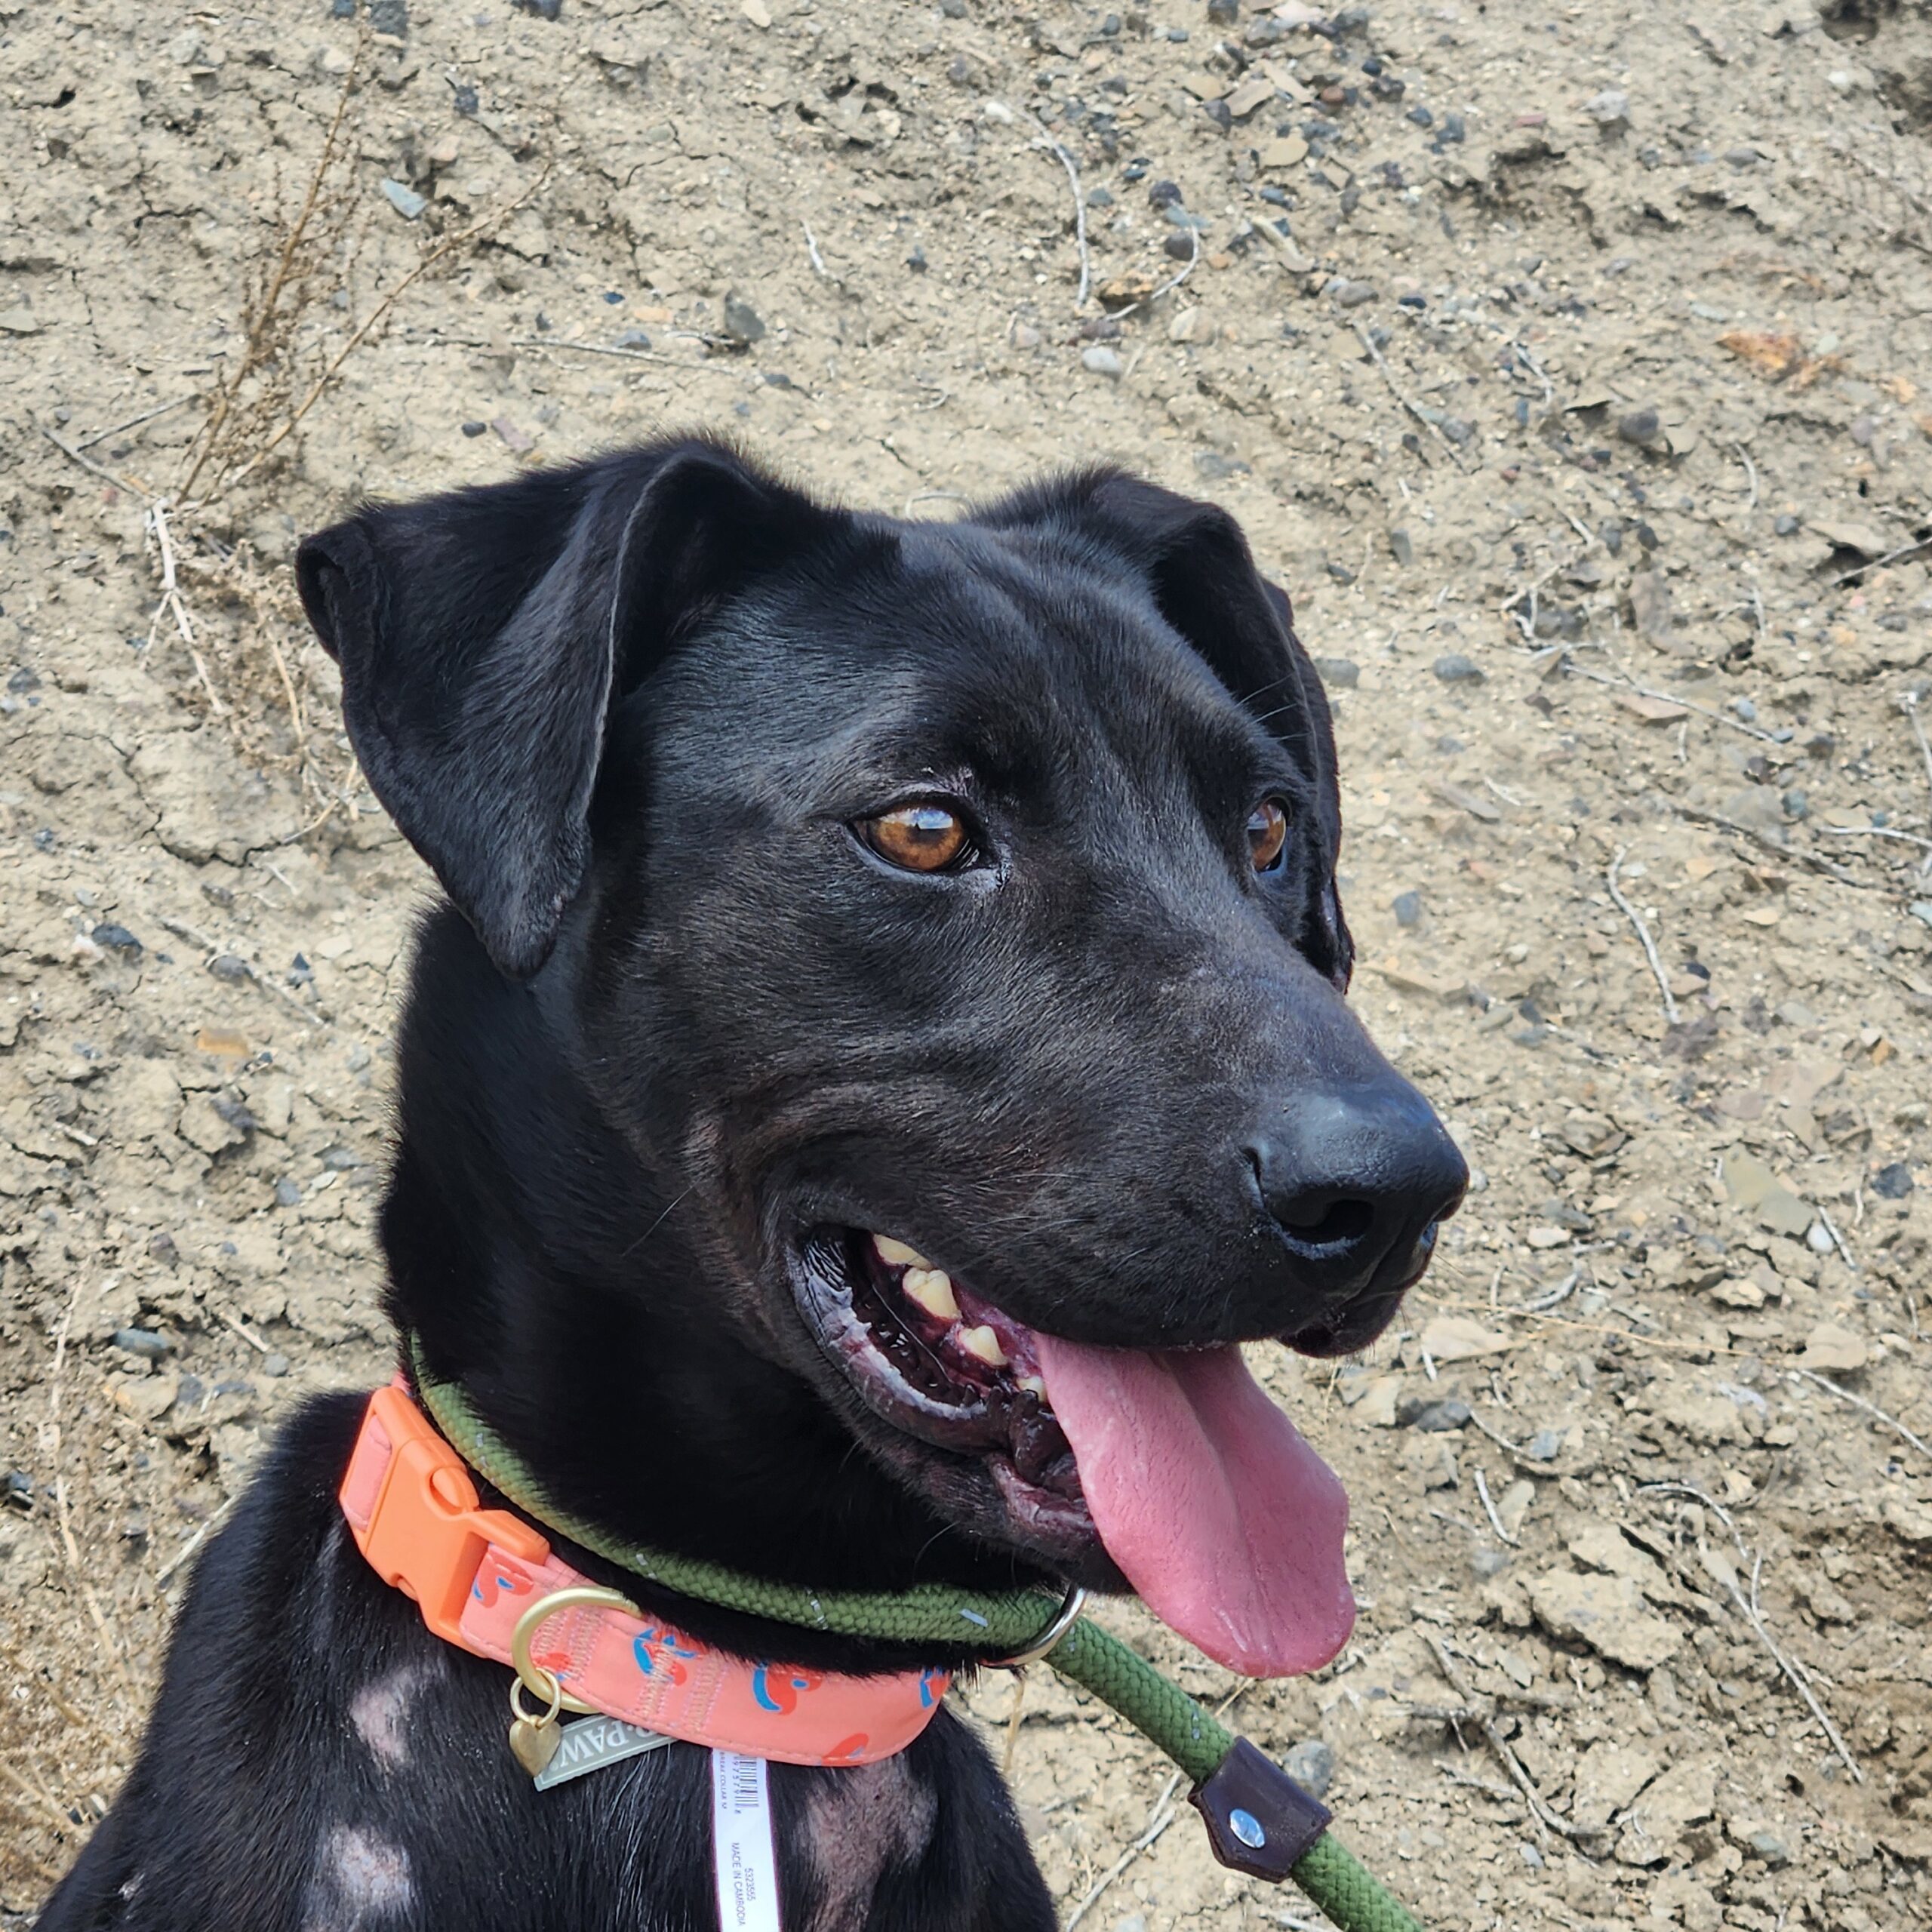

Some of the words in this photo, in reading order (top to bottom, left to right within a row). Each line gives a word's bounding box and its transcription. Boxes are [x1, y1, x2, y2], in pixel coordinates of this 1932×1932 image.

[731, 1842, 742, 1869] MADE
[733, 1869, 743, 1880] IN
[734, 1881, 746, 1927] CAMBODIA
